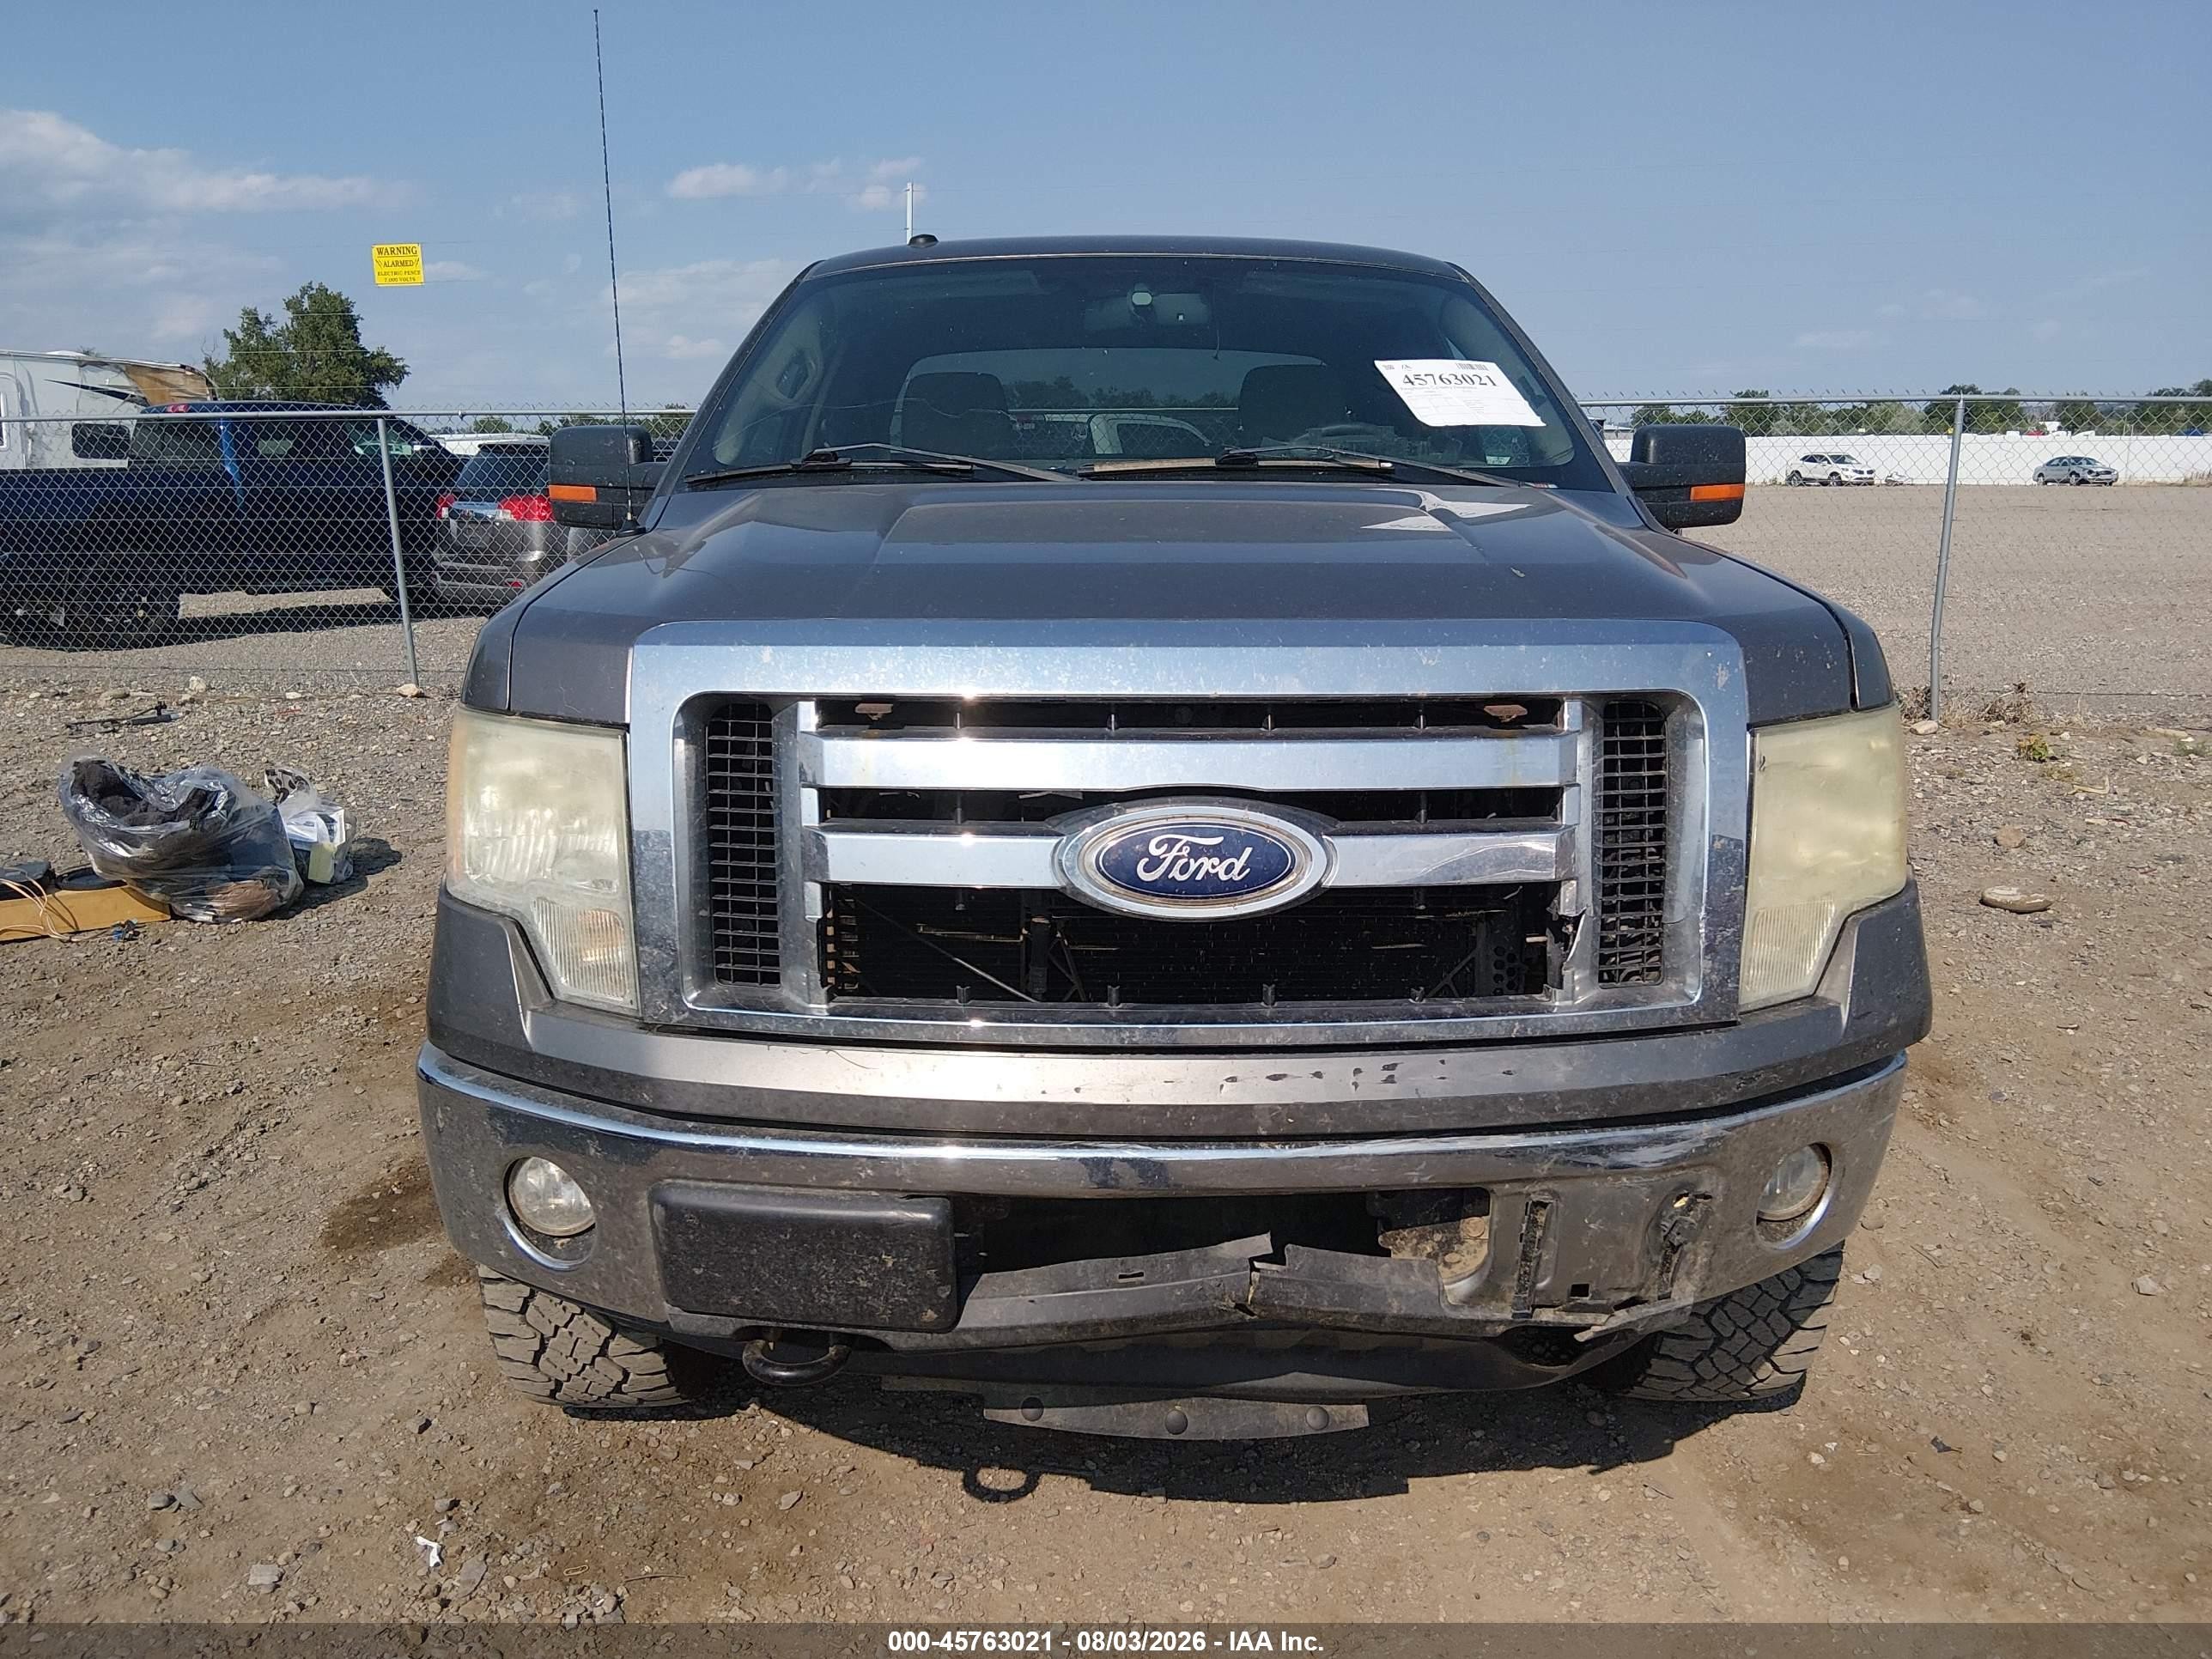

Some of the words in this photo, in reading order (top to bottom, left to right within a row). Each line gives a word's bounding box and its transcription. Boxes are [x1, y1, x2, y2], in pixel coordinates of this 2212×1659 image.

[376, 246, 417, 256] WARNING
[384, 259, 414, 268] ALARMED
[1402, 373, 1498, 386] 45763021
[1136, 834, 1253, 883] Ford
